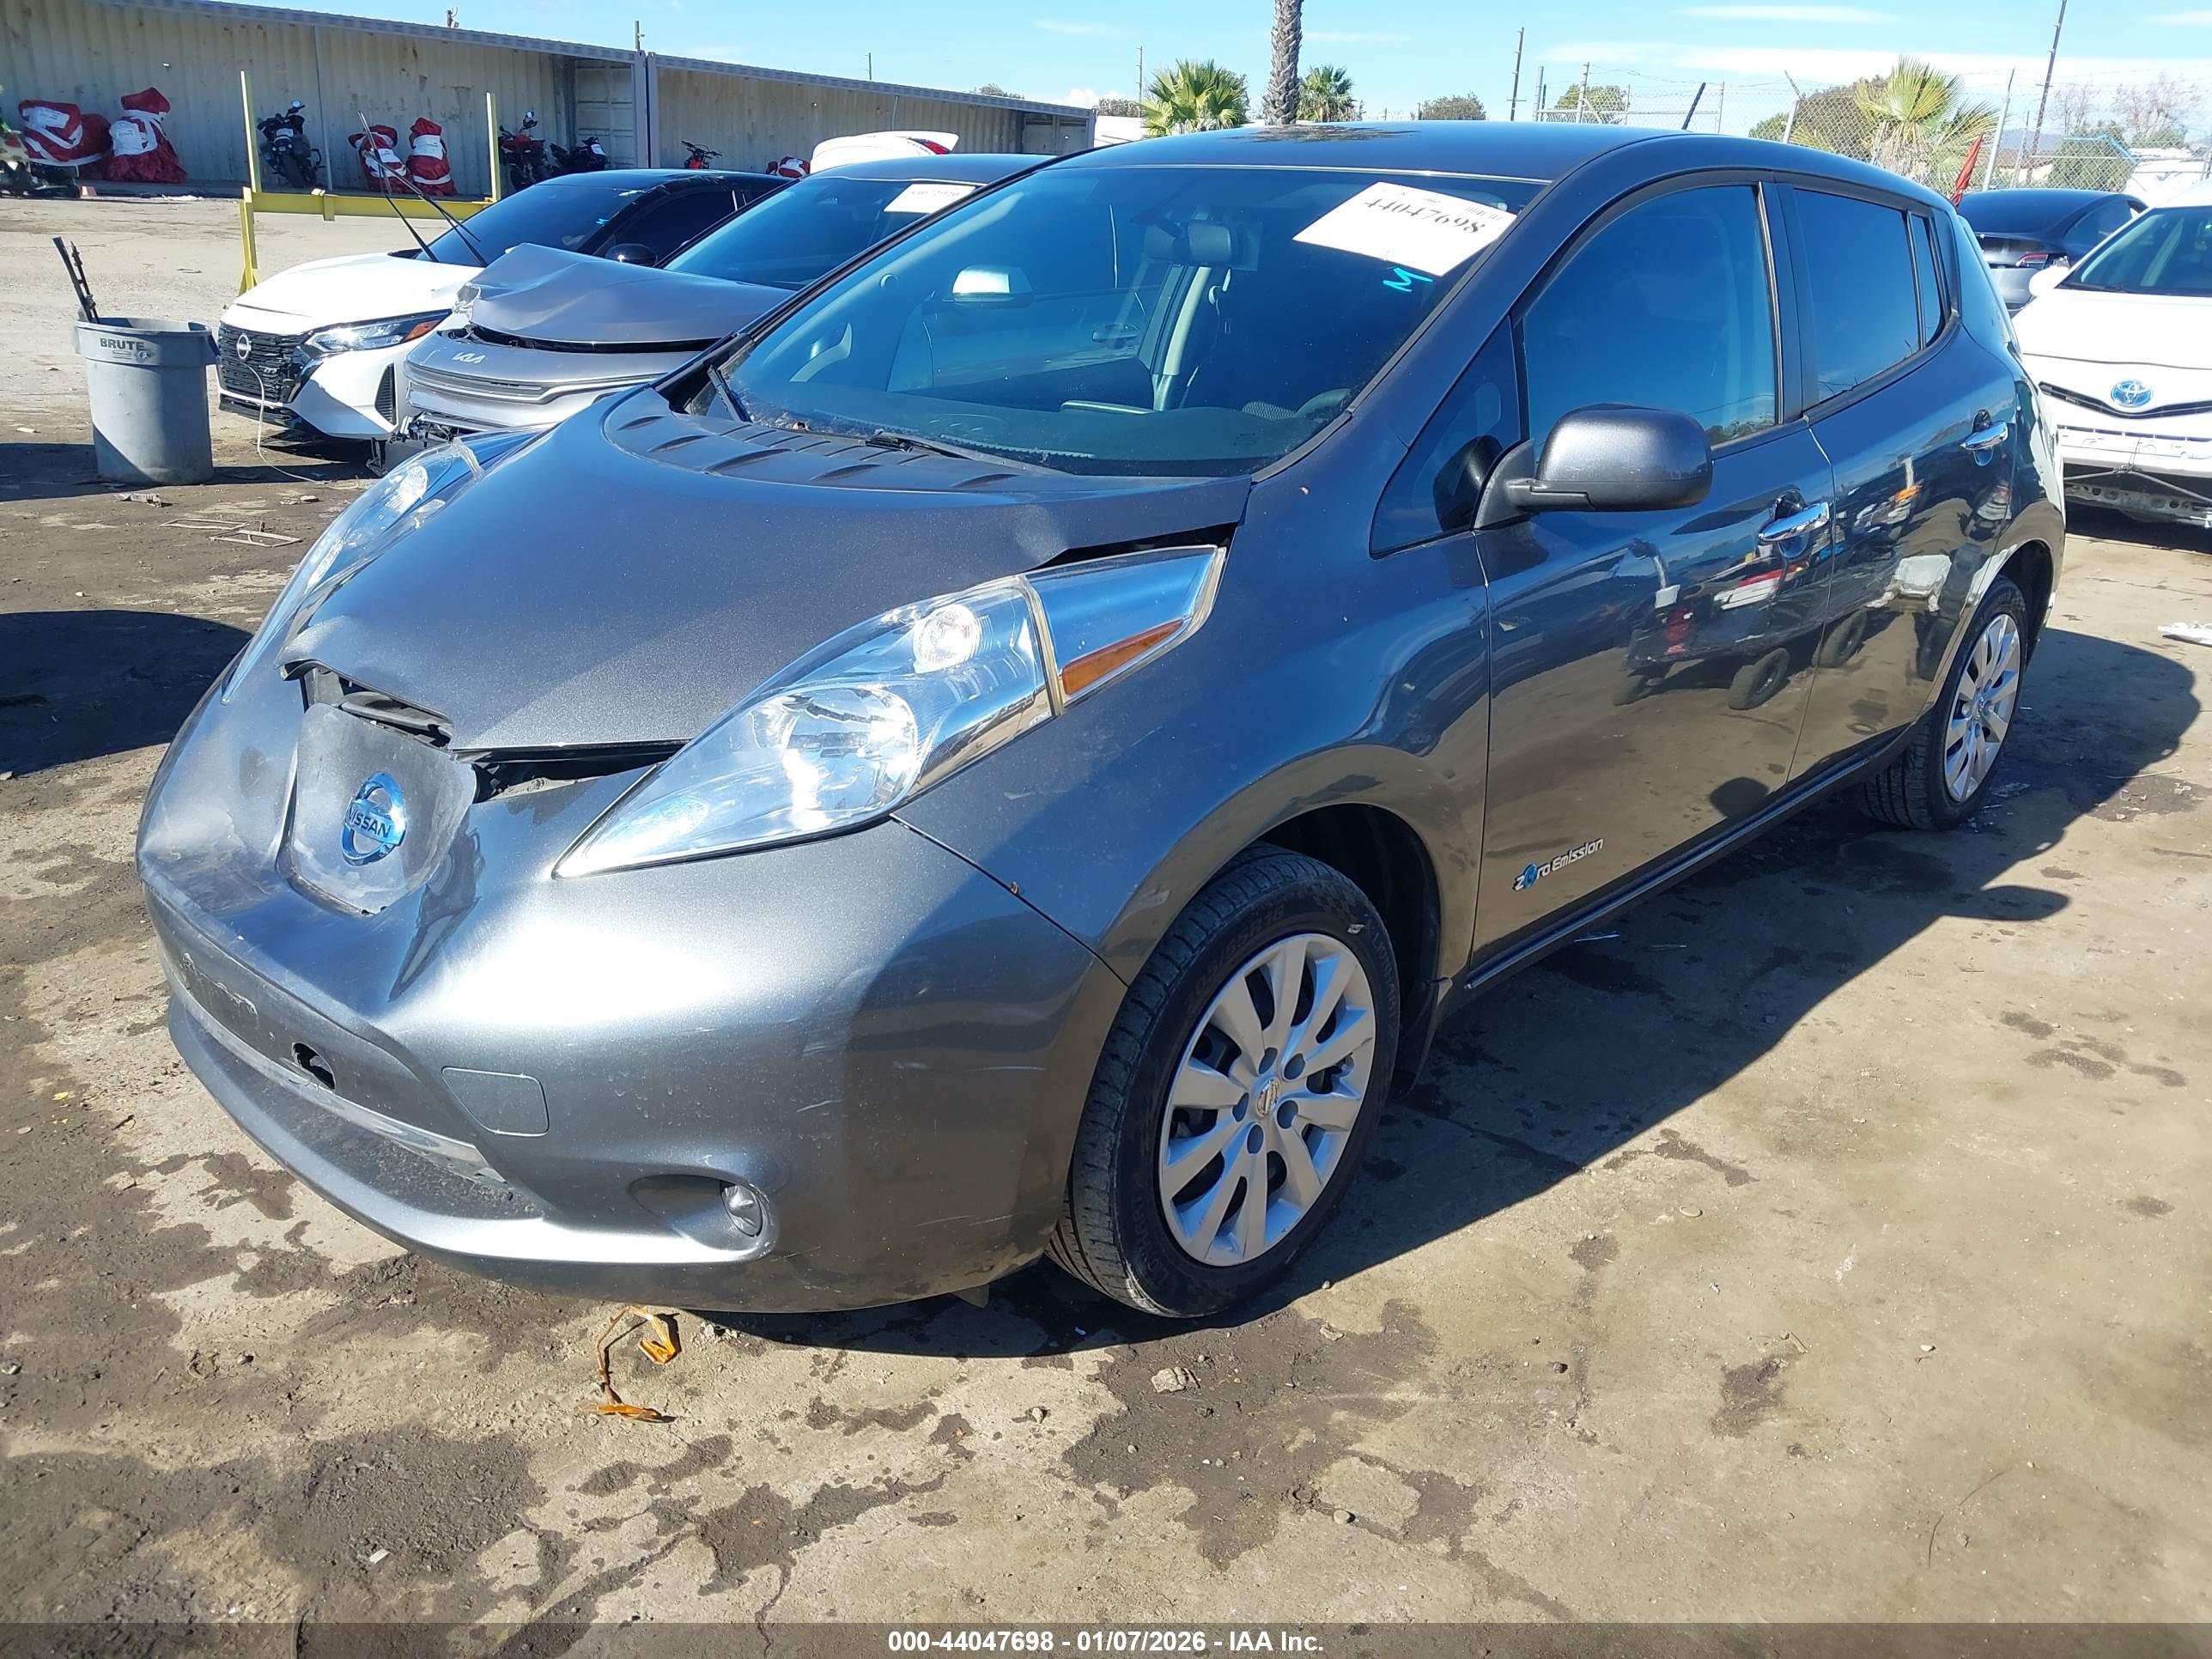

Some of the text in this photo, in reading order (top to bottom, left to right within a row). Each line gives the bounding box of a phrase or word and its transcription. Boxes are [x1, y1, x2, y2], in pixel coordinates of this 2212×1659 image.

[1364, 199, 1485, 234] 44047698
[100, 337, 144, 350] BRUTE
[348, 809, 392, 838] NISSAN
